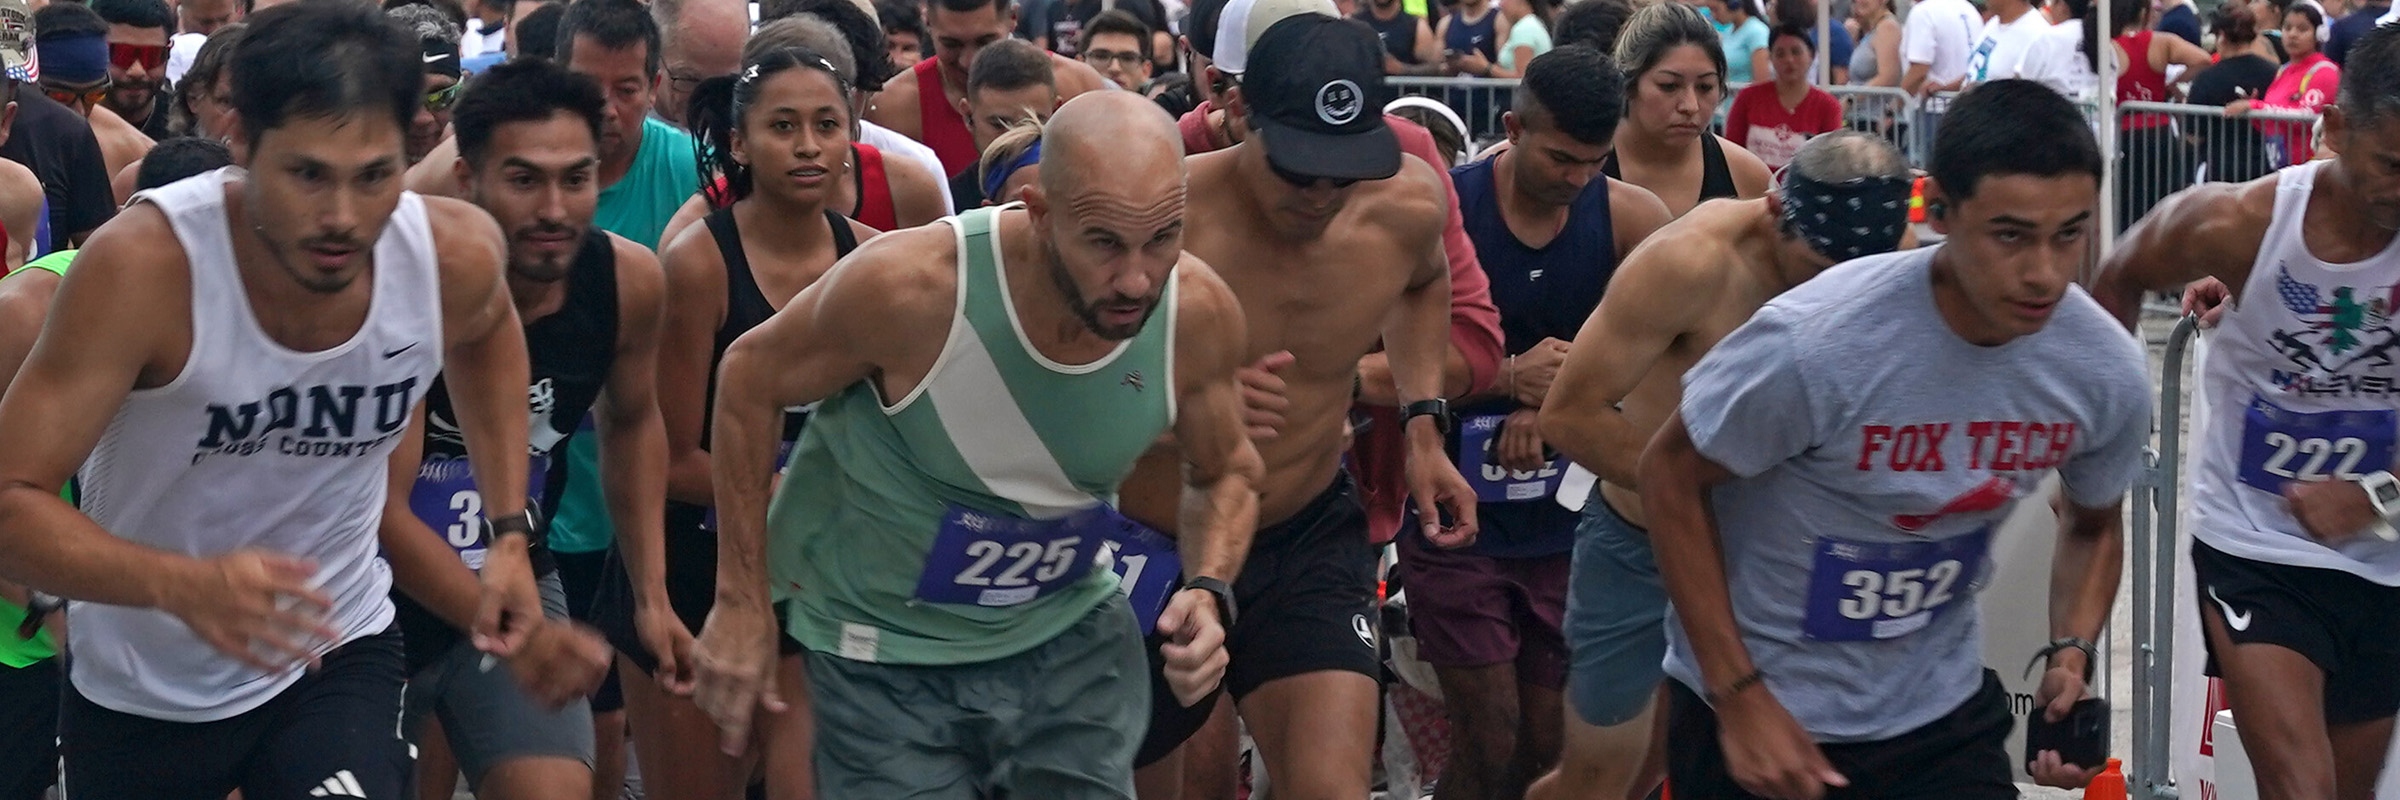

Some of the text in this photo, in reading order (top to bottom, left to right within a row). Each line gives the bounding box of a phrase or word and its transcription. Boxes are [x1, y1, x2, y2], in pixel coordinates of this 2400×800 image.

[198, 376, 418, 448] NDNU
[278, 427, 404, 458] COUNT
[1857, 421, 2075, 471] FOX TECH
[2262, 431, 2369, 482] 222
[953, 535, 1082, 586] 225
[1838, 559, 1963, 620] 352
